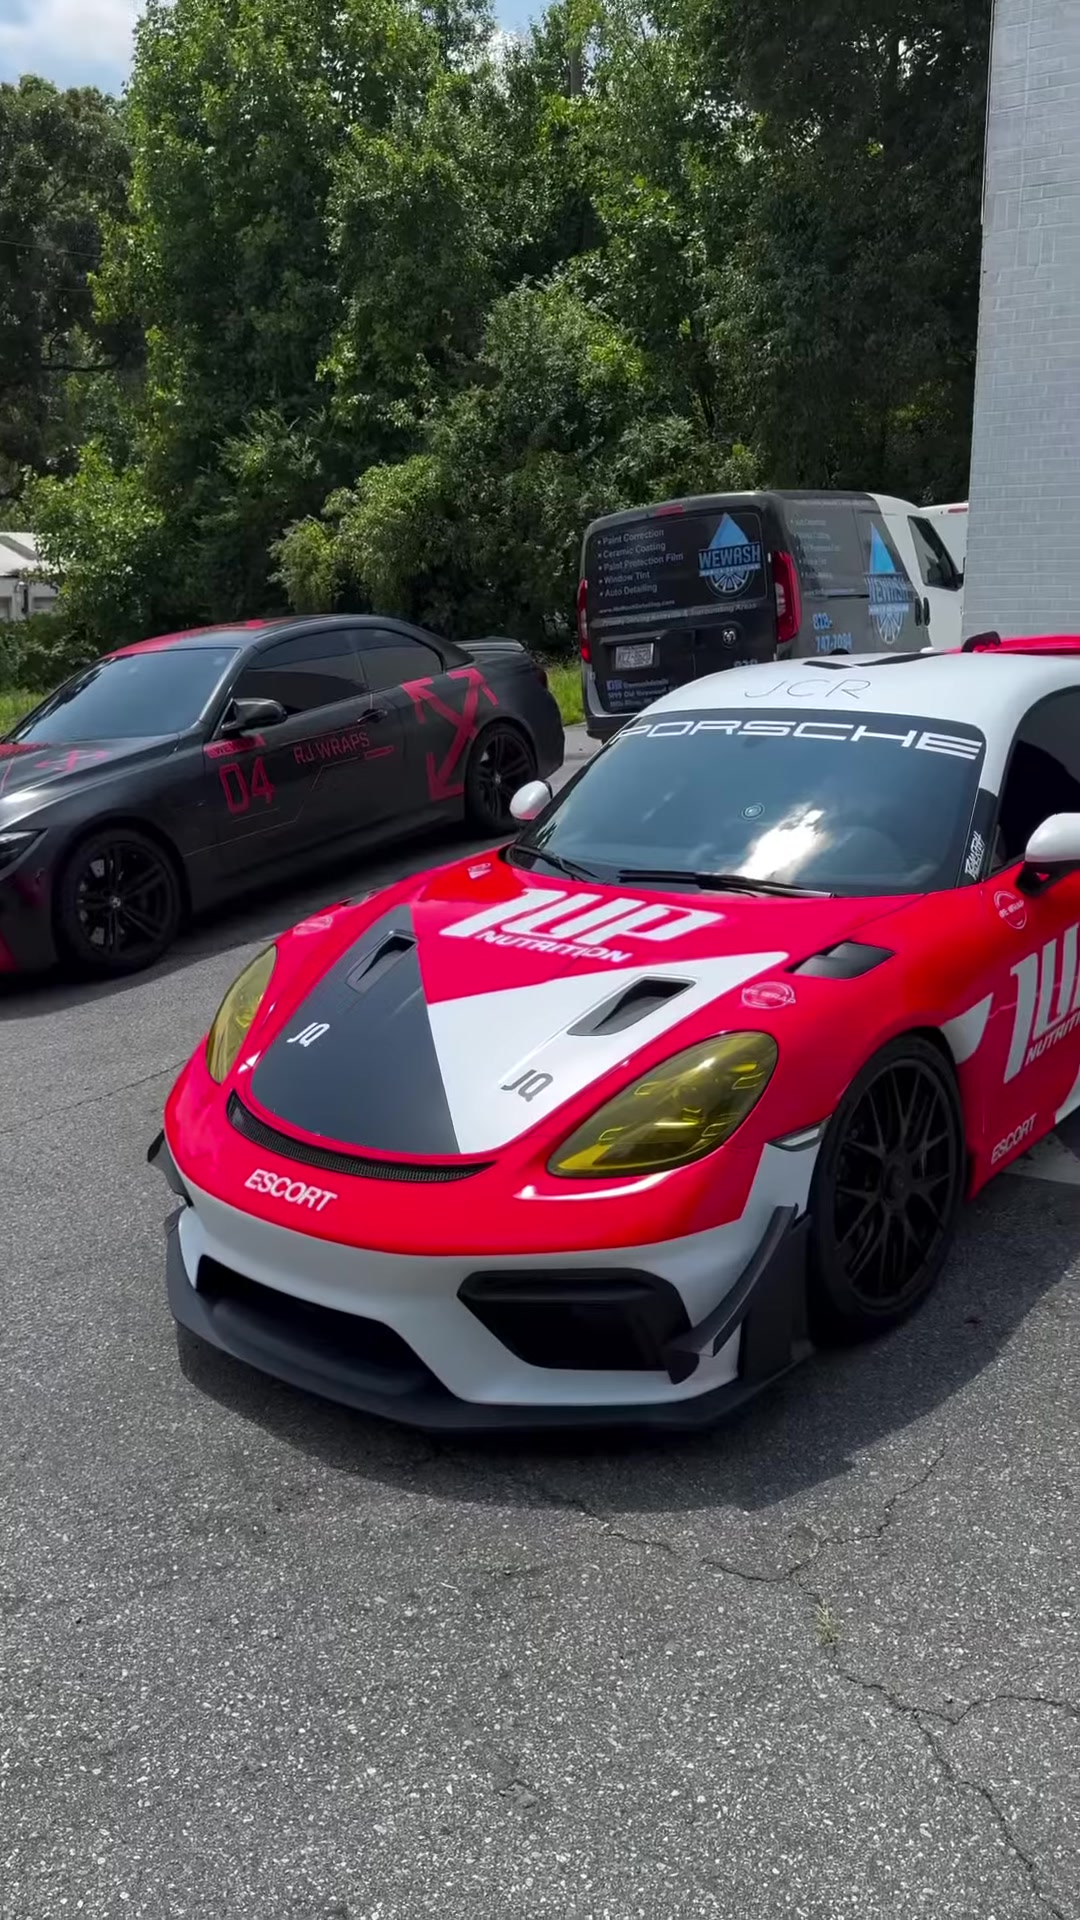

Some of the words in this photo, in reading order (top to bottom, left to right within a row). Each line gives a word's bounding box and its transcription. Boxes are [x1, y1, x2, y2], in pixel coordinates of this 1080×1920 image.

[602, 536, 622, 545] Paint
[623, 529, 665, 542] Correction
[603, 547, 634, 559] Ceramic
[635, 542, 666, 553] Coating
[603, 561, 623, 571] Paint
[624, 555, 665, 568] Protection
[665, 552, 684, 562] Film
[698, 544, 760, 570] WEWASH
[603, 574, 634, 585] Window
[635, 571, 651, 580] Tint
[605, 588, 622, 597] Auto
[623, 584, 658, 595] Detailing
[743, 678, 872, 700] JCR
[315, 732, 370, 760] WRAPS
[609, 719, 984, 761] PORSCHE
[218, 755, 275, 816] 04
[438, 887, 727, 947] 1UP
[474, 929, 634, 963] NUTRITION
[1003, 921, 1080, 1085] 1U
[286, 1021, 331, 1048] JQ
[1025, 1010, 1080, 1067] NUTRITI
[500, 1069, 554, 1102] JQ
[990, 1112, 1038, 1166] ESCORT
[243, 1167, 338, 1212] ESCORT
